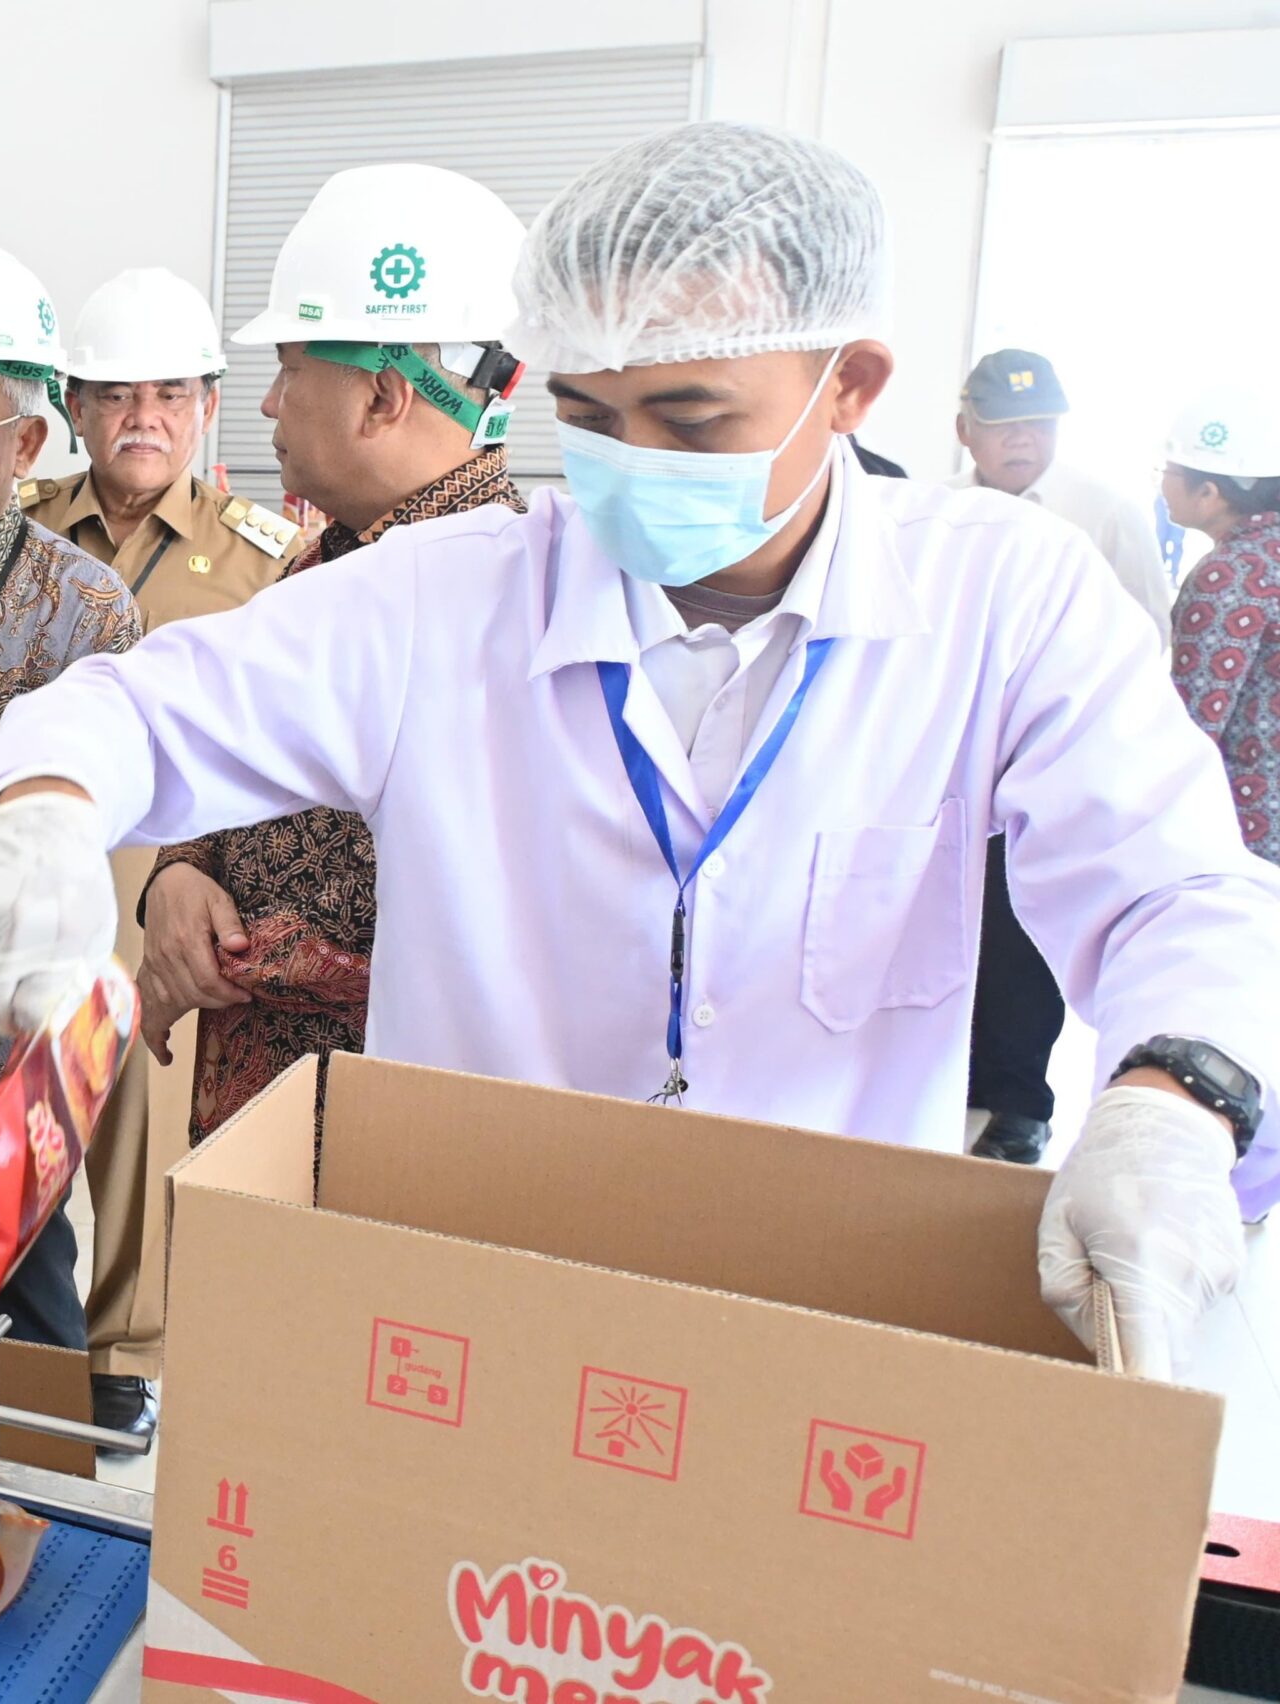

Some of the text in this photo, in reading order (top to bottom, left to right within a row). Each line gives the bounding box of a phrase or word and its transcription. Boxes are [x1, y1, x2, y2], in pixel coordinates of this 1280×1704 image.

[300, 305, 321, 317] MSA
[365, 304, 428, 314] SAFETY FIRST
[414, 369, 463, 415] WORK
[217, 1544, 238, 1572] 6
[455, 1563, 766, 1704] Minyak
